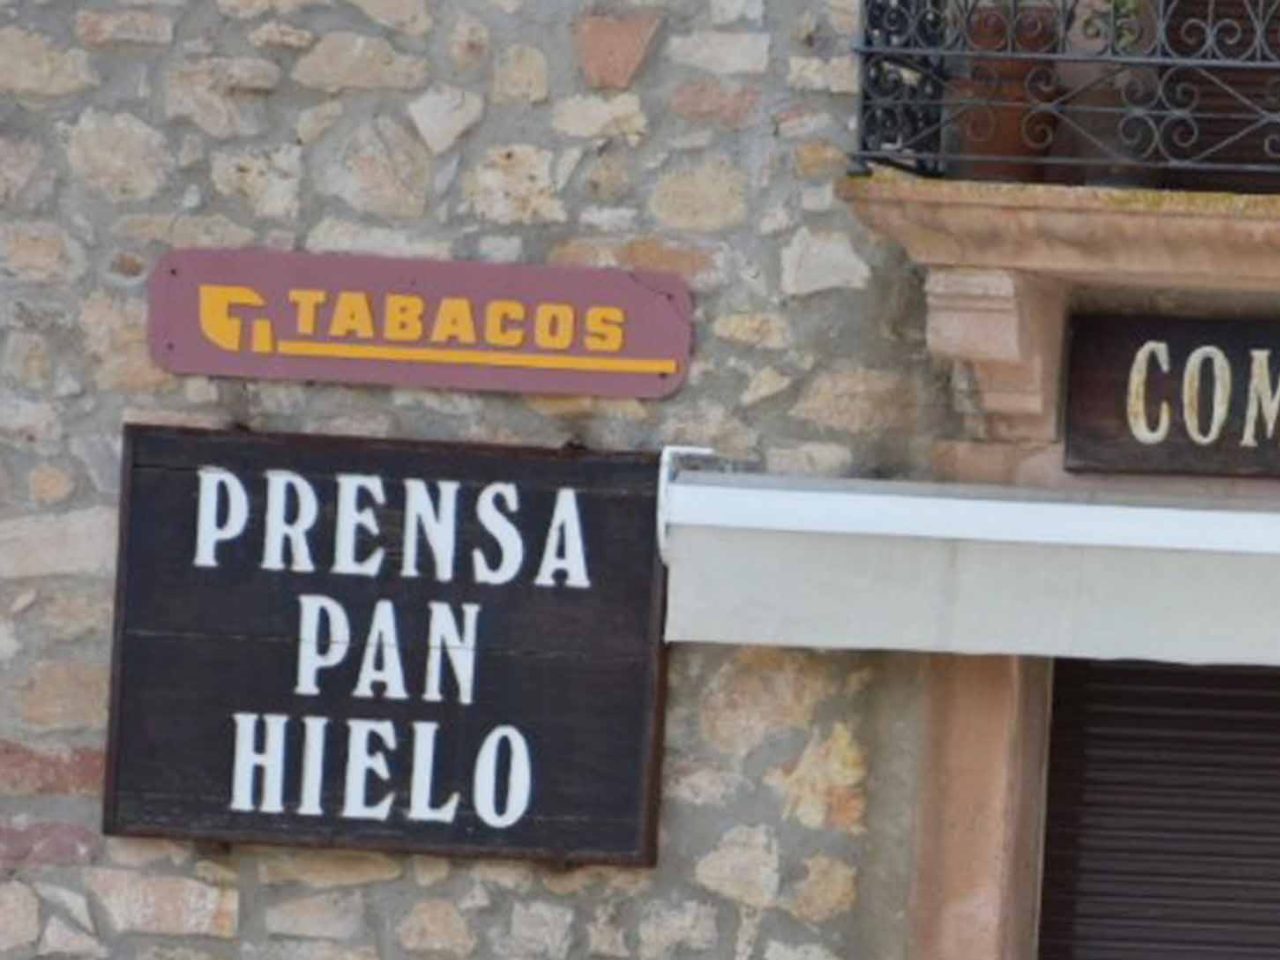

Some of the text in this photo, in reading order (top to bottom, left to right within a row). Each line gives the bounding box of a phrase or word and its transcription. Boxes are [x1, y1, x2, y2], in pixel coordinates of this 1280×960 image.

[290, 289, 627, 353] TABACOS
[193, 465, 591, 590] PRENSA
[294, 594, 481, 705] PAN
[229, 712, 532, 829] HIELO
